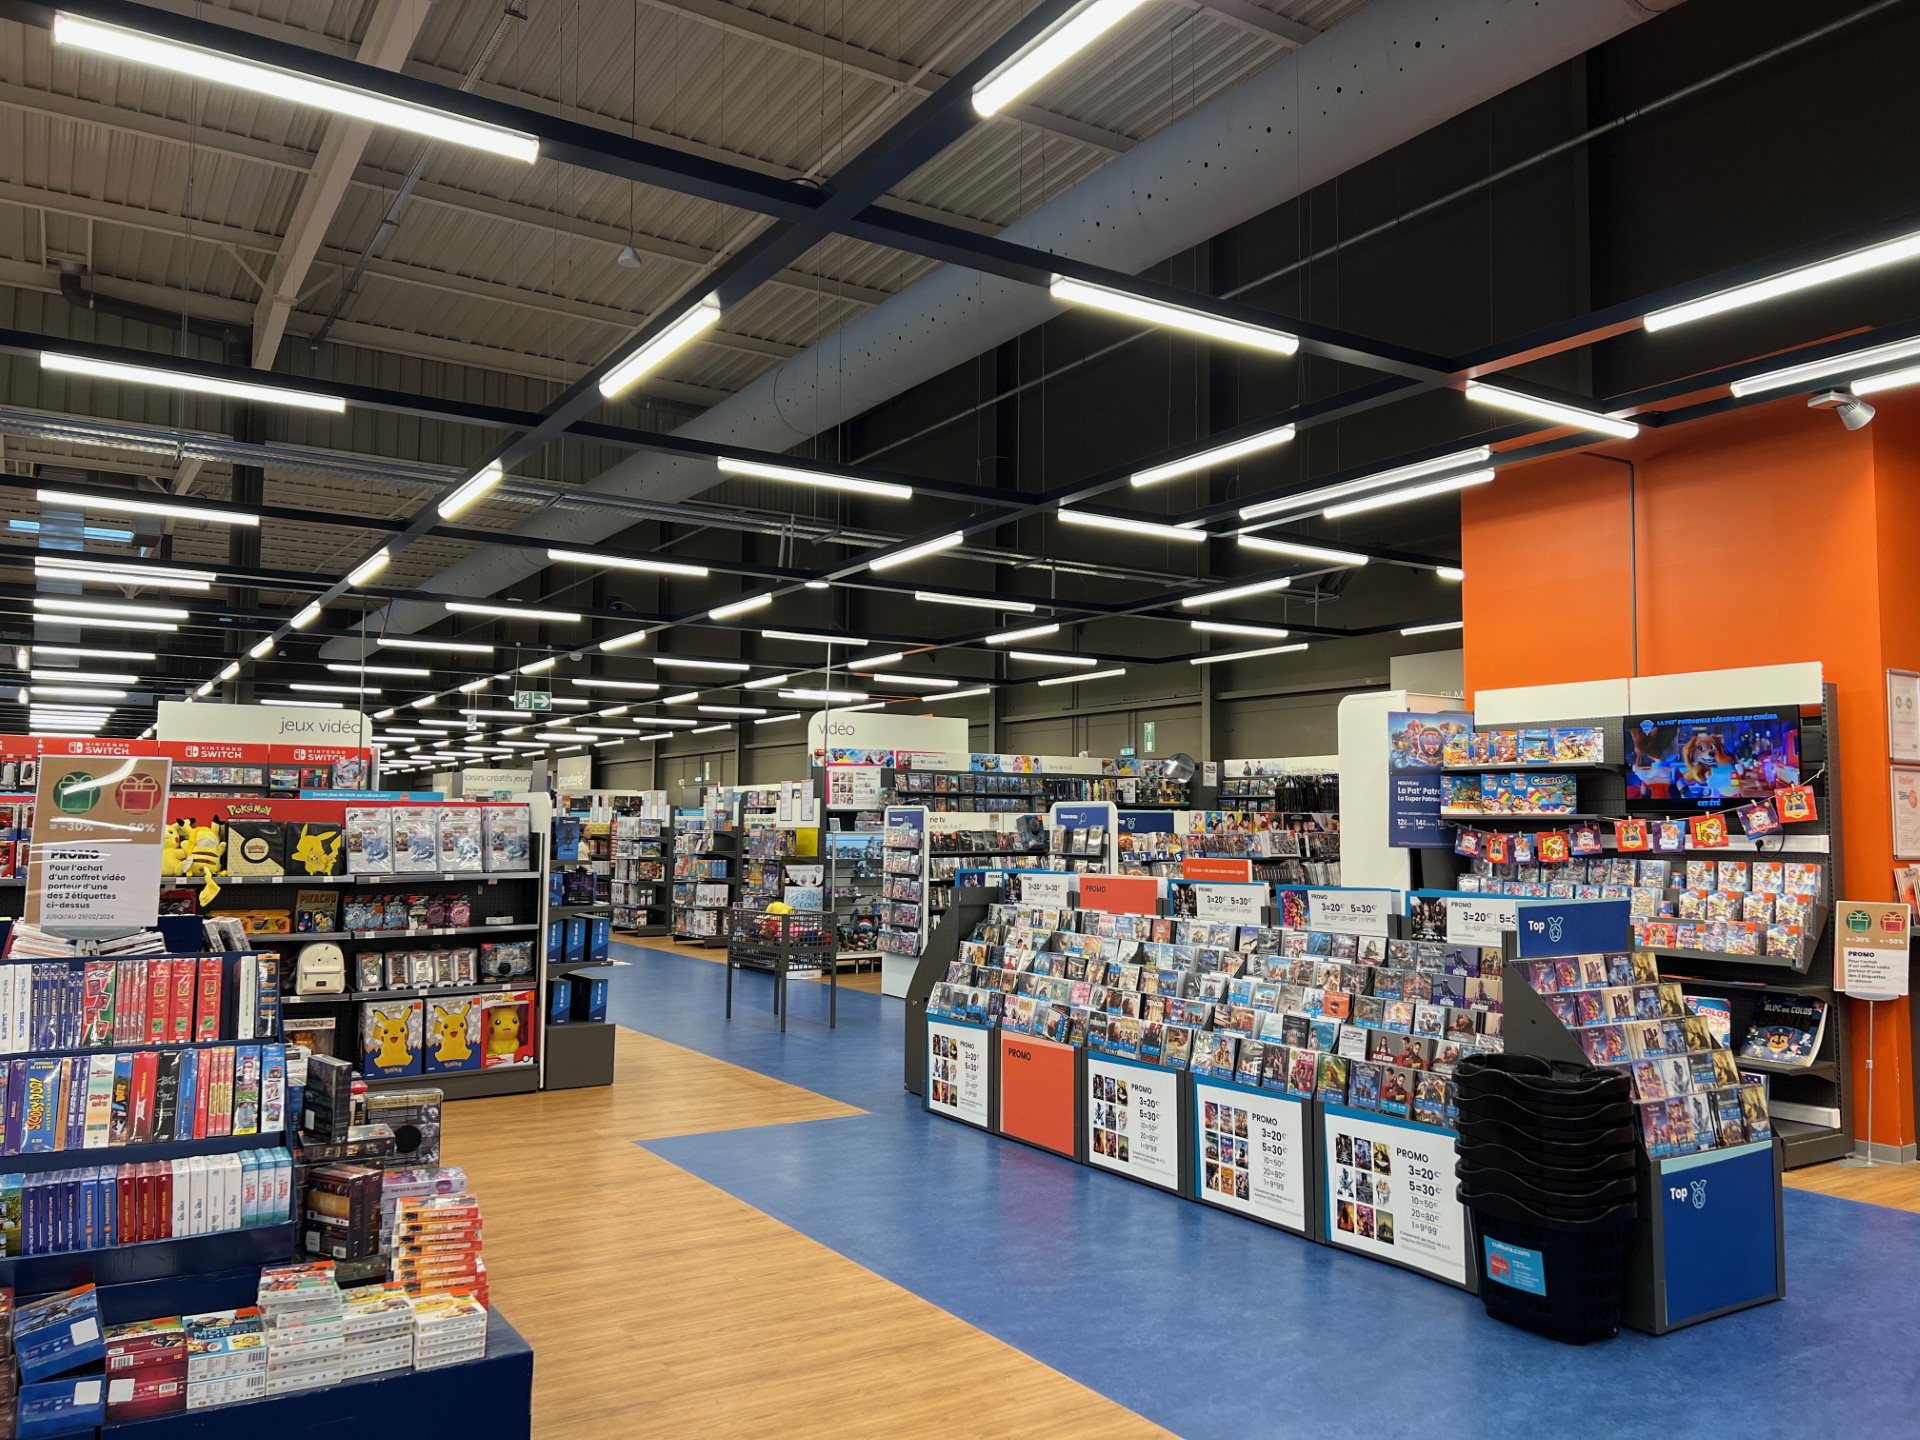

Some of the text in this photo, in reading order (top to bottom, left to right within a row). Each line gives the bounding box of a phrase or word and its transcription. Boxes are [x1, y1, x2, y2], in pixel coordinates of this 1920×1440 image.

[279, 717, 314, 734] jeux
[818, 722, 855, 735] vdéo
[85, 747, 130, 755] SWITCH
[201, 751, 243, 759] SWITCH
[307, 754, 346, 762] SWITCH
[464, 773, 485, 781] loisirs
[486, 773, 513, 782] créatifs
[1531, 775, 1567, 785] Colorino
[1397, 786, 1406, 794] La
[1407, 786, 1422, 794] Pat'
[1405, 795, 1422, 803] Super
[50, 849, 100, 860] PROMO
[1158, 852, 1164, 860] 4
[71, 864, 103, 872] l'achat
[48, 873, 126, 881] d'un coffret vidéo
[1085, 884, 1106, 893] PROMO
[71, 891, 117, 900] étiquettes
[300, 893, 337, 904] PIKACHU
[46, 901, 90, 909] ci-dessus
[1528, 920, 1545, 933] Top
[1698, 1006, 1729, 1019] COLOS
[1764, 1004, 1781, 1012] BLOC
[1790, 1007, 1813, 1016] COLOS
[960, 1040, 975, 1050] PROMO
[1008, 1047, 1032, 1061] PROMO
[1131, 1083, 1152, 1094] PROMO
[1252, 1112, 1278, 1126] PROMO
[1396, 1147, 1429, 1163] PROMO
[1669, 1187, 1688, 1202] Top
[1491, 1241, 1531, 1257] cultura.com
